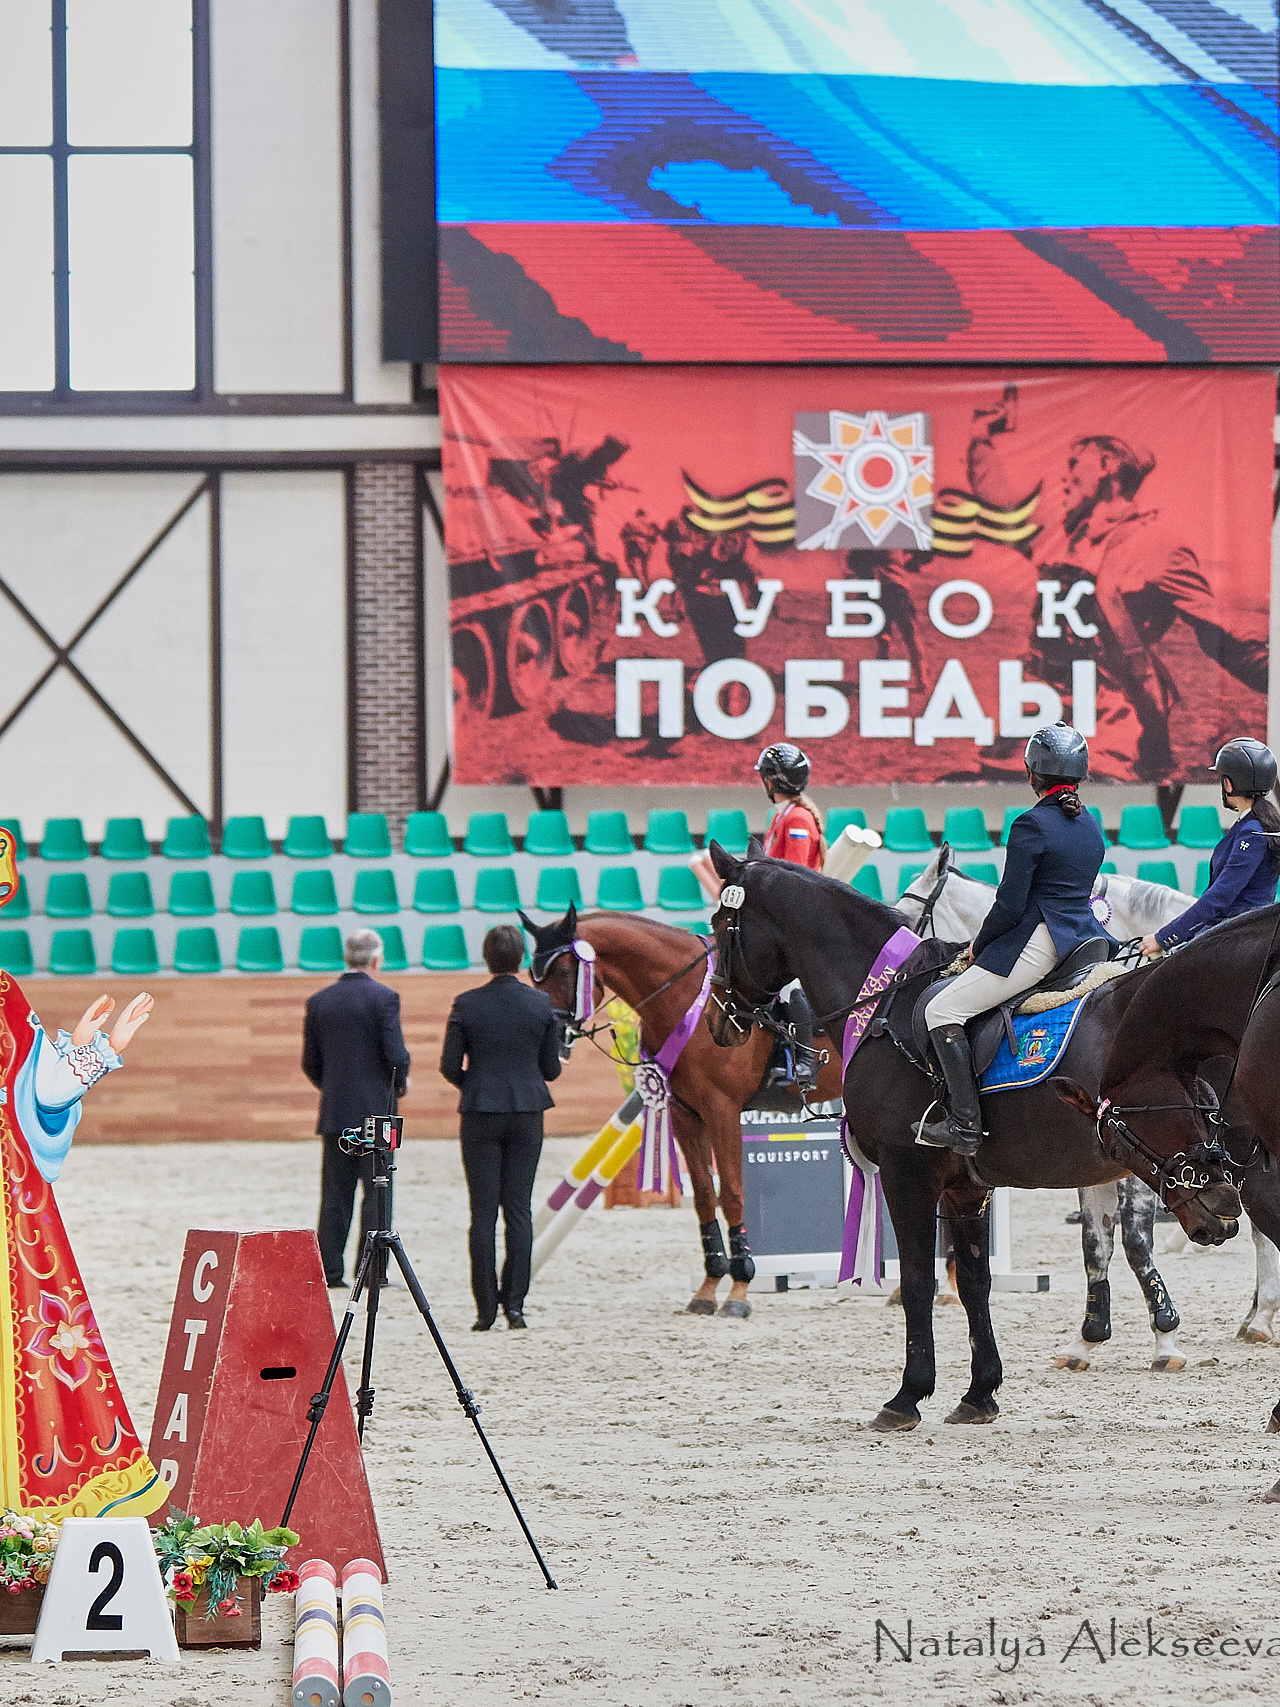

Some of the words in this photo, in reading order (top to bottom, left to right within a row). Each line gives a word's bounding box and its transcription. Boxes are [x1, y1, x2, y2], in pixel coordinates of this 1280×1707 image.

[615, 578, 1099, 639] КУБОК
[615, 657, 1097, 746] ПОБЕДЫ
[851, 964, 897, 1038] MAIMA
[747, 1149, 829, 1163] EQUISPORT
[85, 1541, 124, 1631] 2
